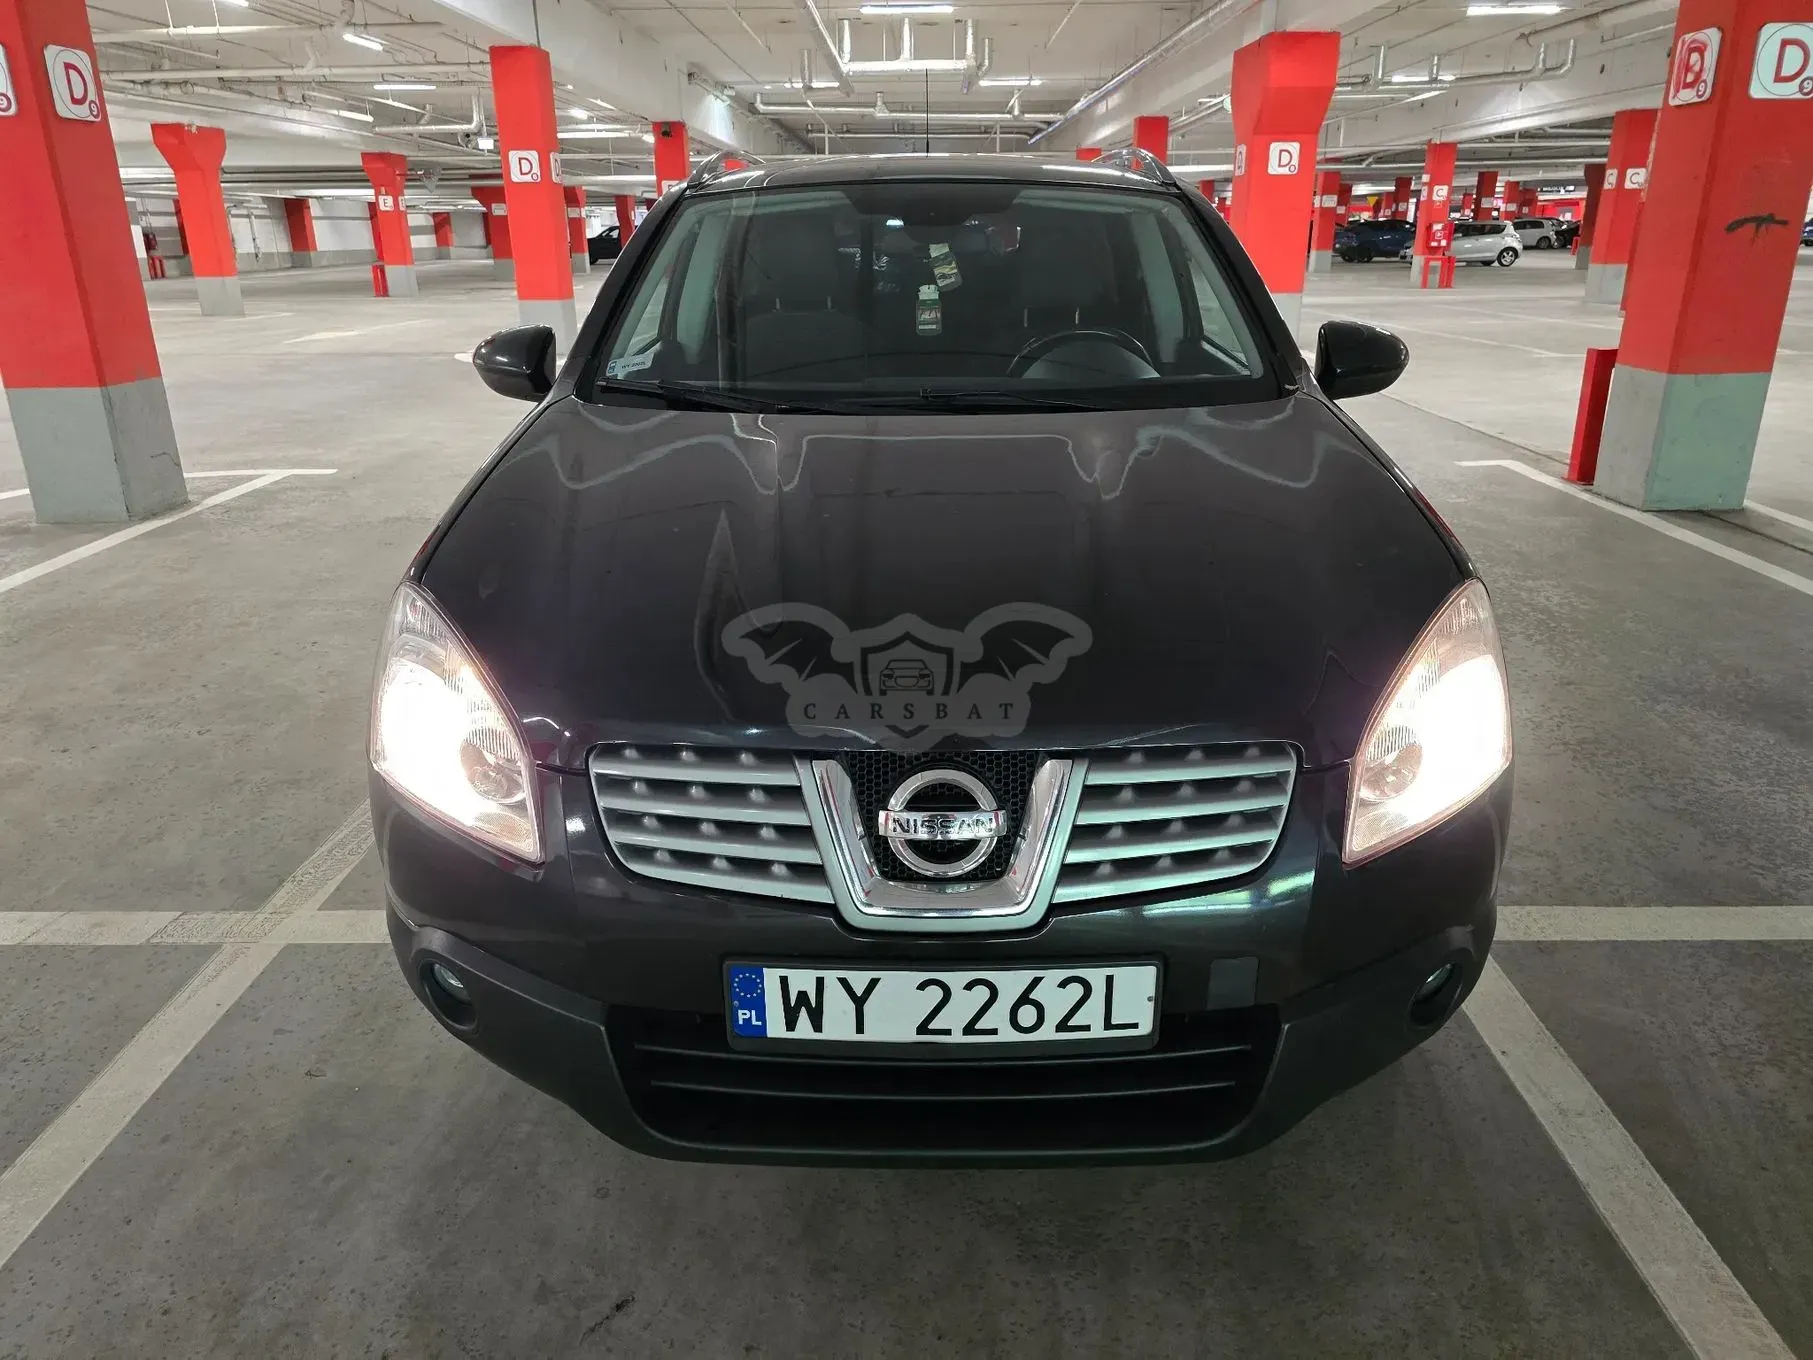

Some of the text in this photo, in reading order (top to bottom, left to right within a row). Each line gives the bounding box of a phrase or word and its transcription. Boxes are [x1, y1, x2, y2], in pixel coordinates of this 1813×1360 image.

[1772, 38, 1810, 83] D
[63, 61, 88, 106] D
[518, 157, 533, 176] D
[1278, 149, 1292, 168] D
[892, 817, 993, 834] NISSAN
[737, 974, 1140, 1037] PL WY 2262L
